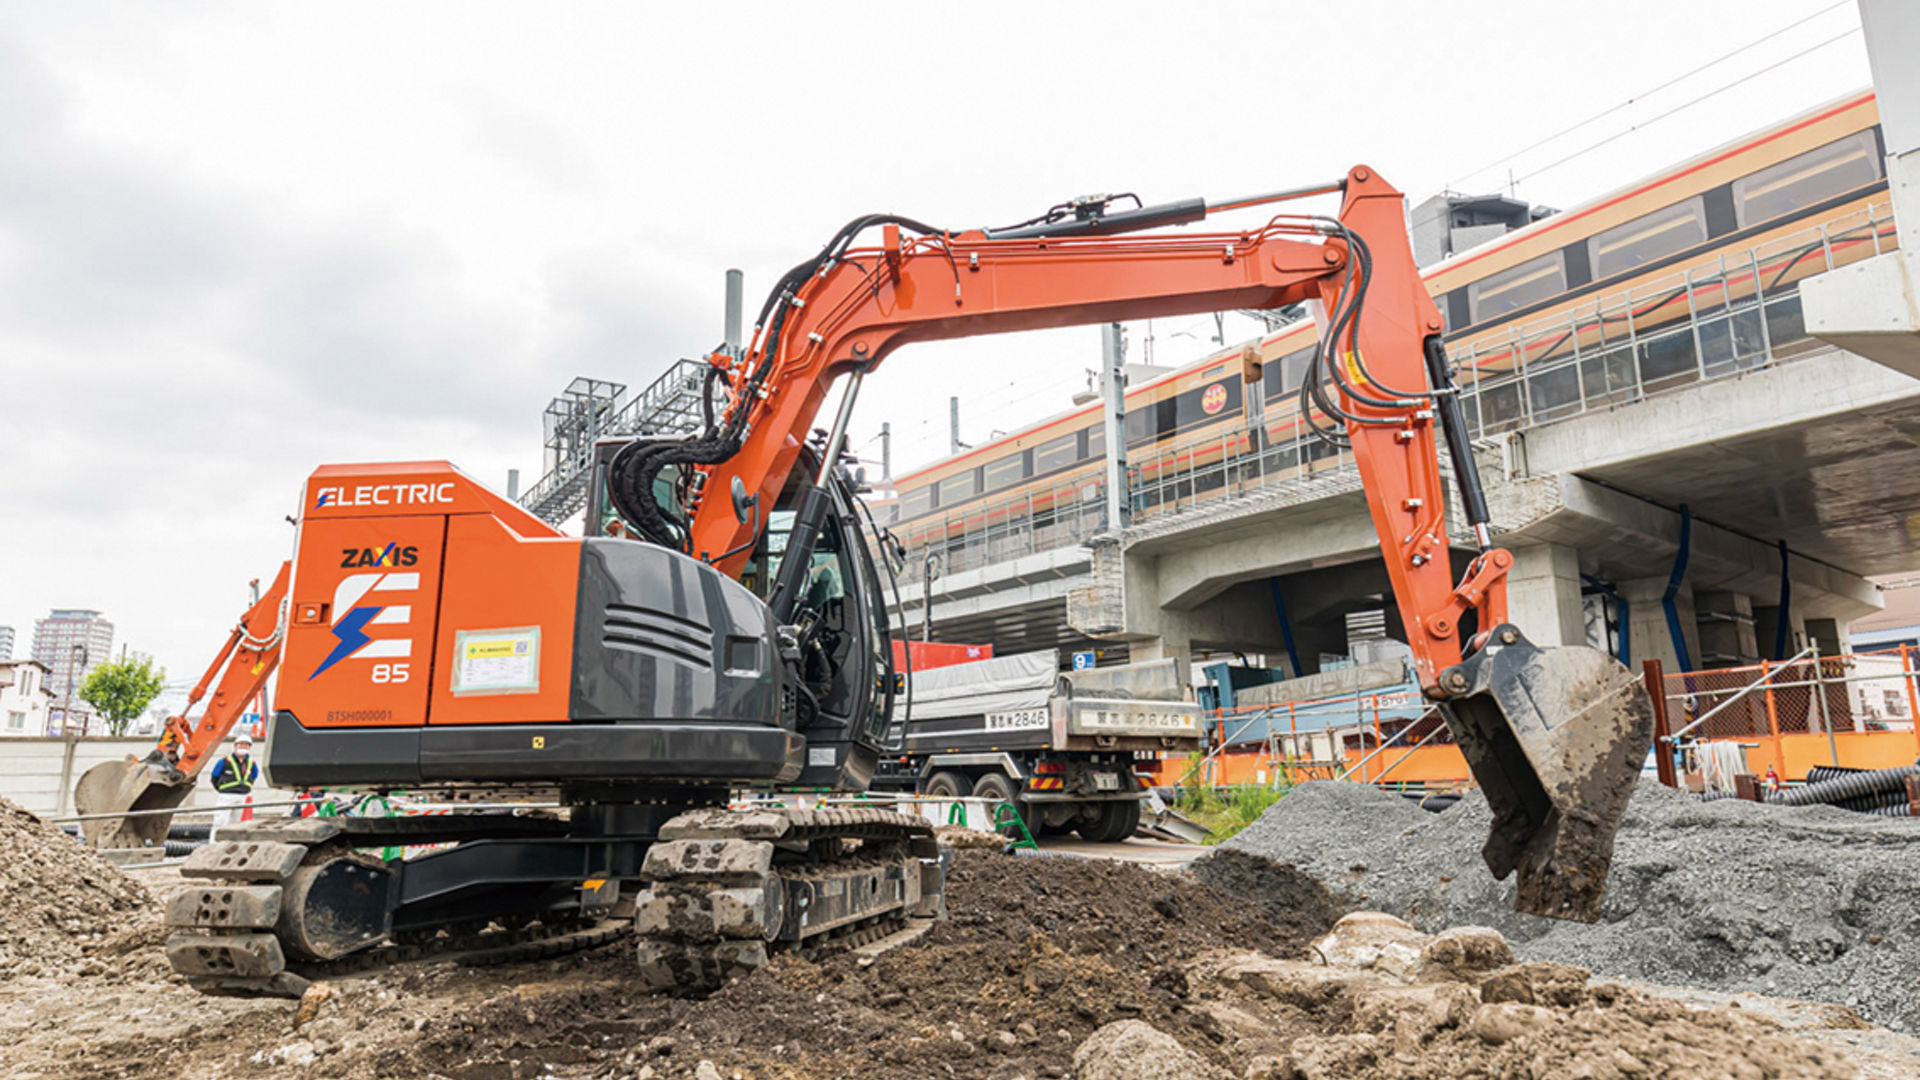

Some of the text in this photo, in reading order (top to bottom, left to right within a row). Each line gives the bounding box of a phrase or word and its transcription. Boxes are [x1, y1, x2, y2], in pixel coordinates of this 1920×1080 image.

[315, 483, 455, 508] ELECTRIC
[341, 542, 418, 568] ZAXIS
[372, 664, 410, 683] 85
[1015, 711, 1045, 727] 2846
[1137, 713, 1180, 728] 2846
